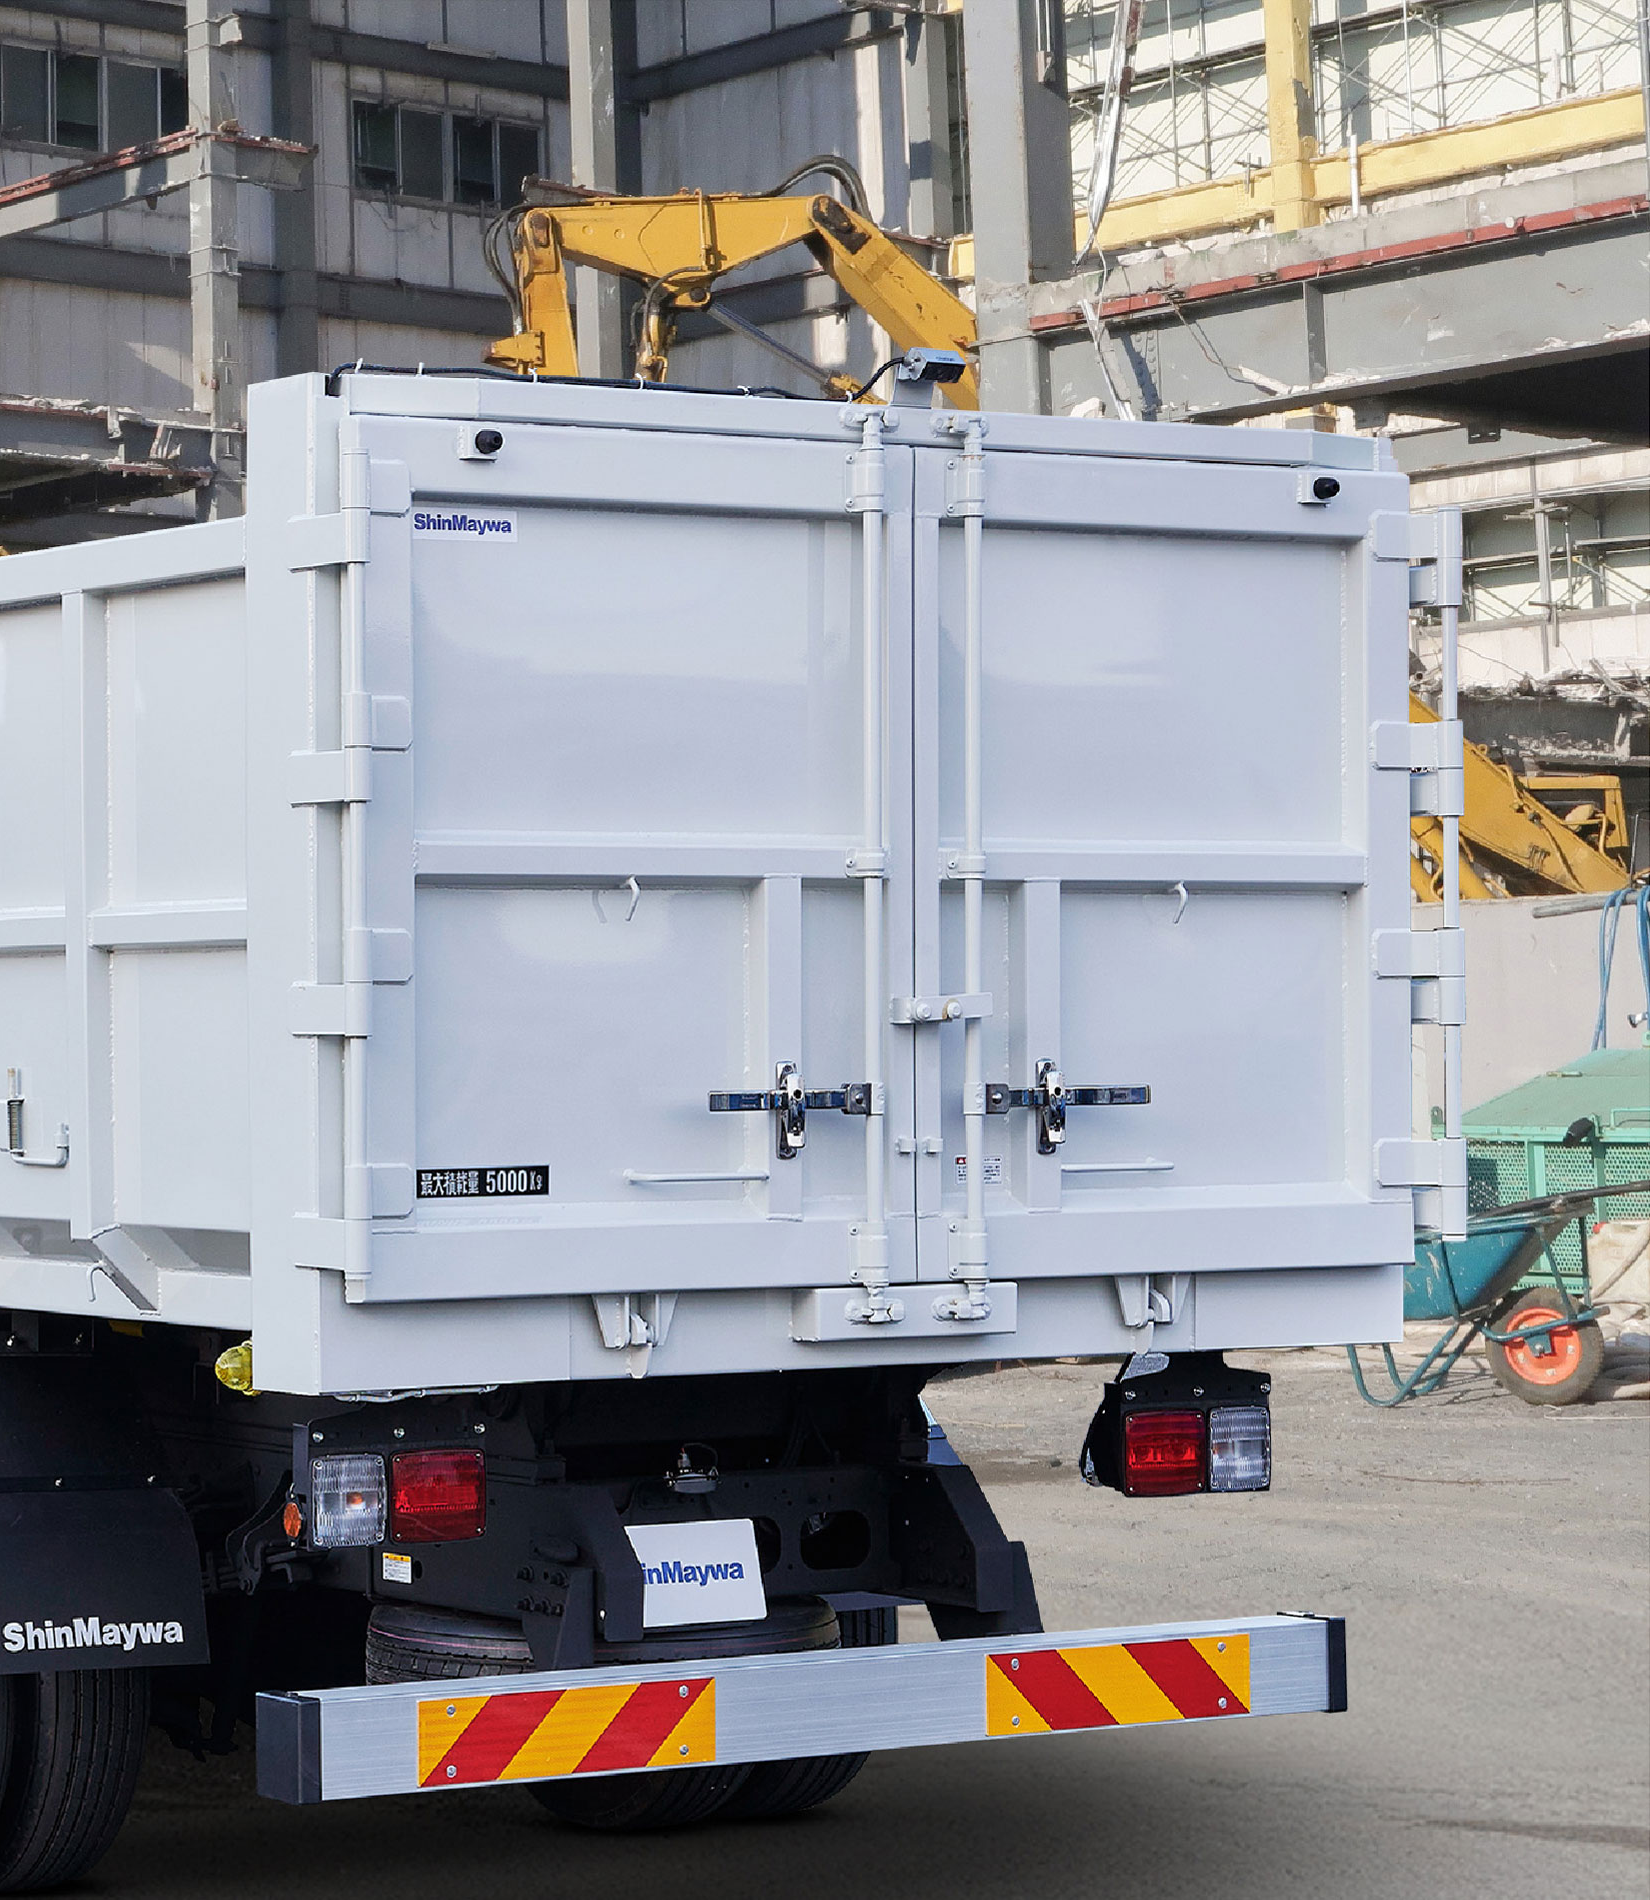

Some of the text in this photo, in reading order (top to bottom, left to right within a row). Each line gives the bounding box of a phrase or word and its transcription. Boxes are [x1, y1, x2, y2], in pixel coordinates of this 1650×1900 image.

[414, 513, 512, 536] ShinMaywa
[421, 1170, 480, 1196] 最大積載量
[642, 1561, 745, 1587] inMaywa
[2, 1617, 185, 1652] ShinMaywa
